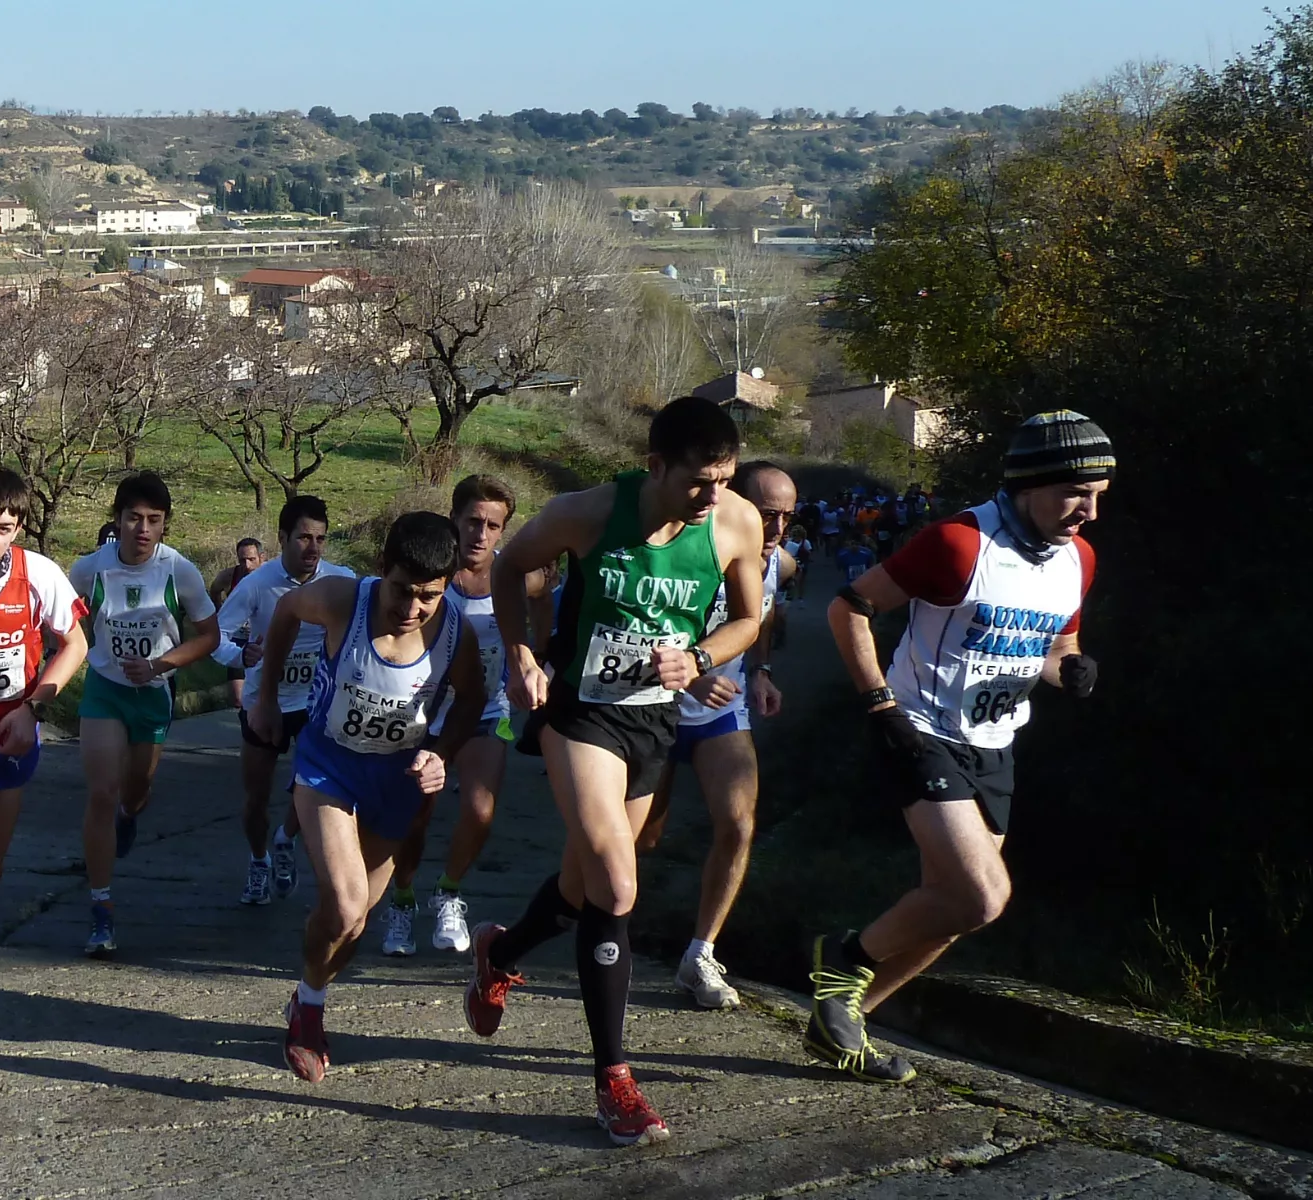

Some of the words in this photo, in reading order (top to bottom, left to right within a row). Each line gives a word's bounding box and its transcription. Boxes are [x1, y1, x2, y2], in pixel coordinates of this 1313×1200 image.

[599, 567, 636, 607] EL
[636, 575, 700, 618] CISNE
[104, 618, 147, 630] KELME
[615, 617, 674, 635] JACA
[112, 635, 152, 658] 830
[597, 626, 669, 648] KELME
[279, 665, 312, 684] 09
[971, 664, 1030, 677] KELME
[343, 682, 407, 710] KELME
[971, 689, 1022, 724] 864
[343, 708, 407, 742] 856
